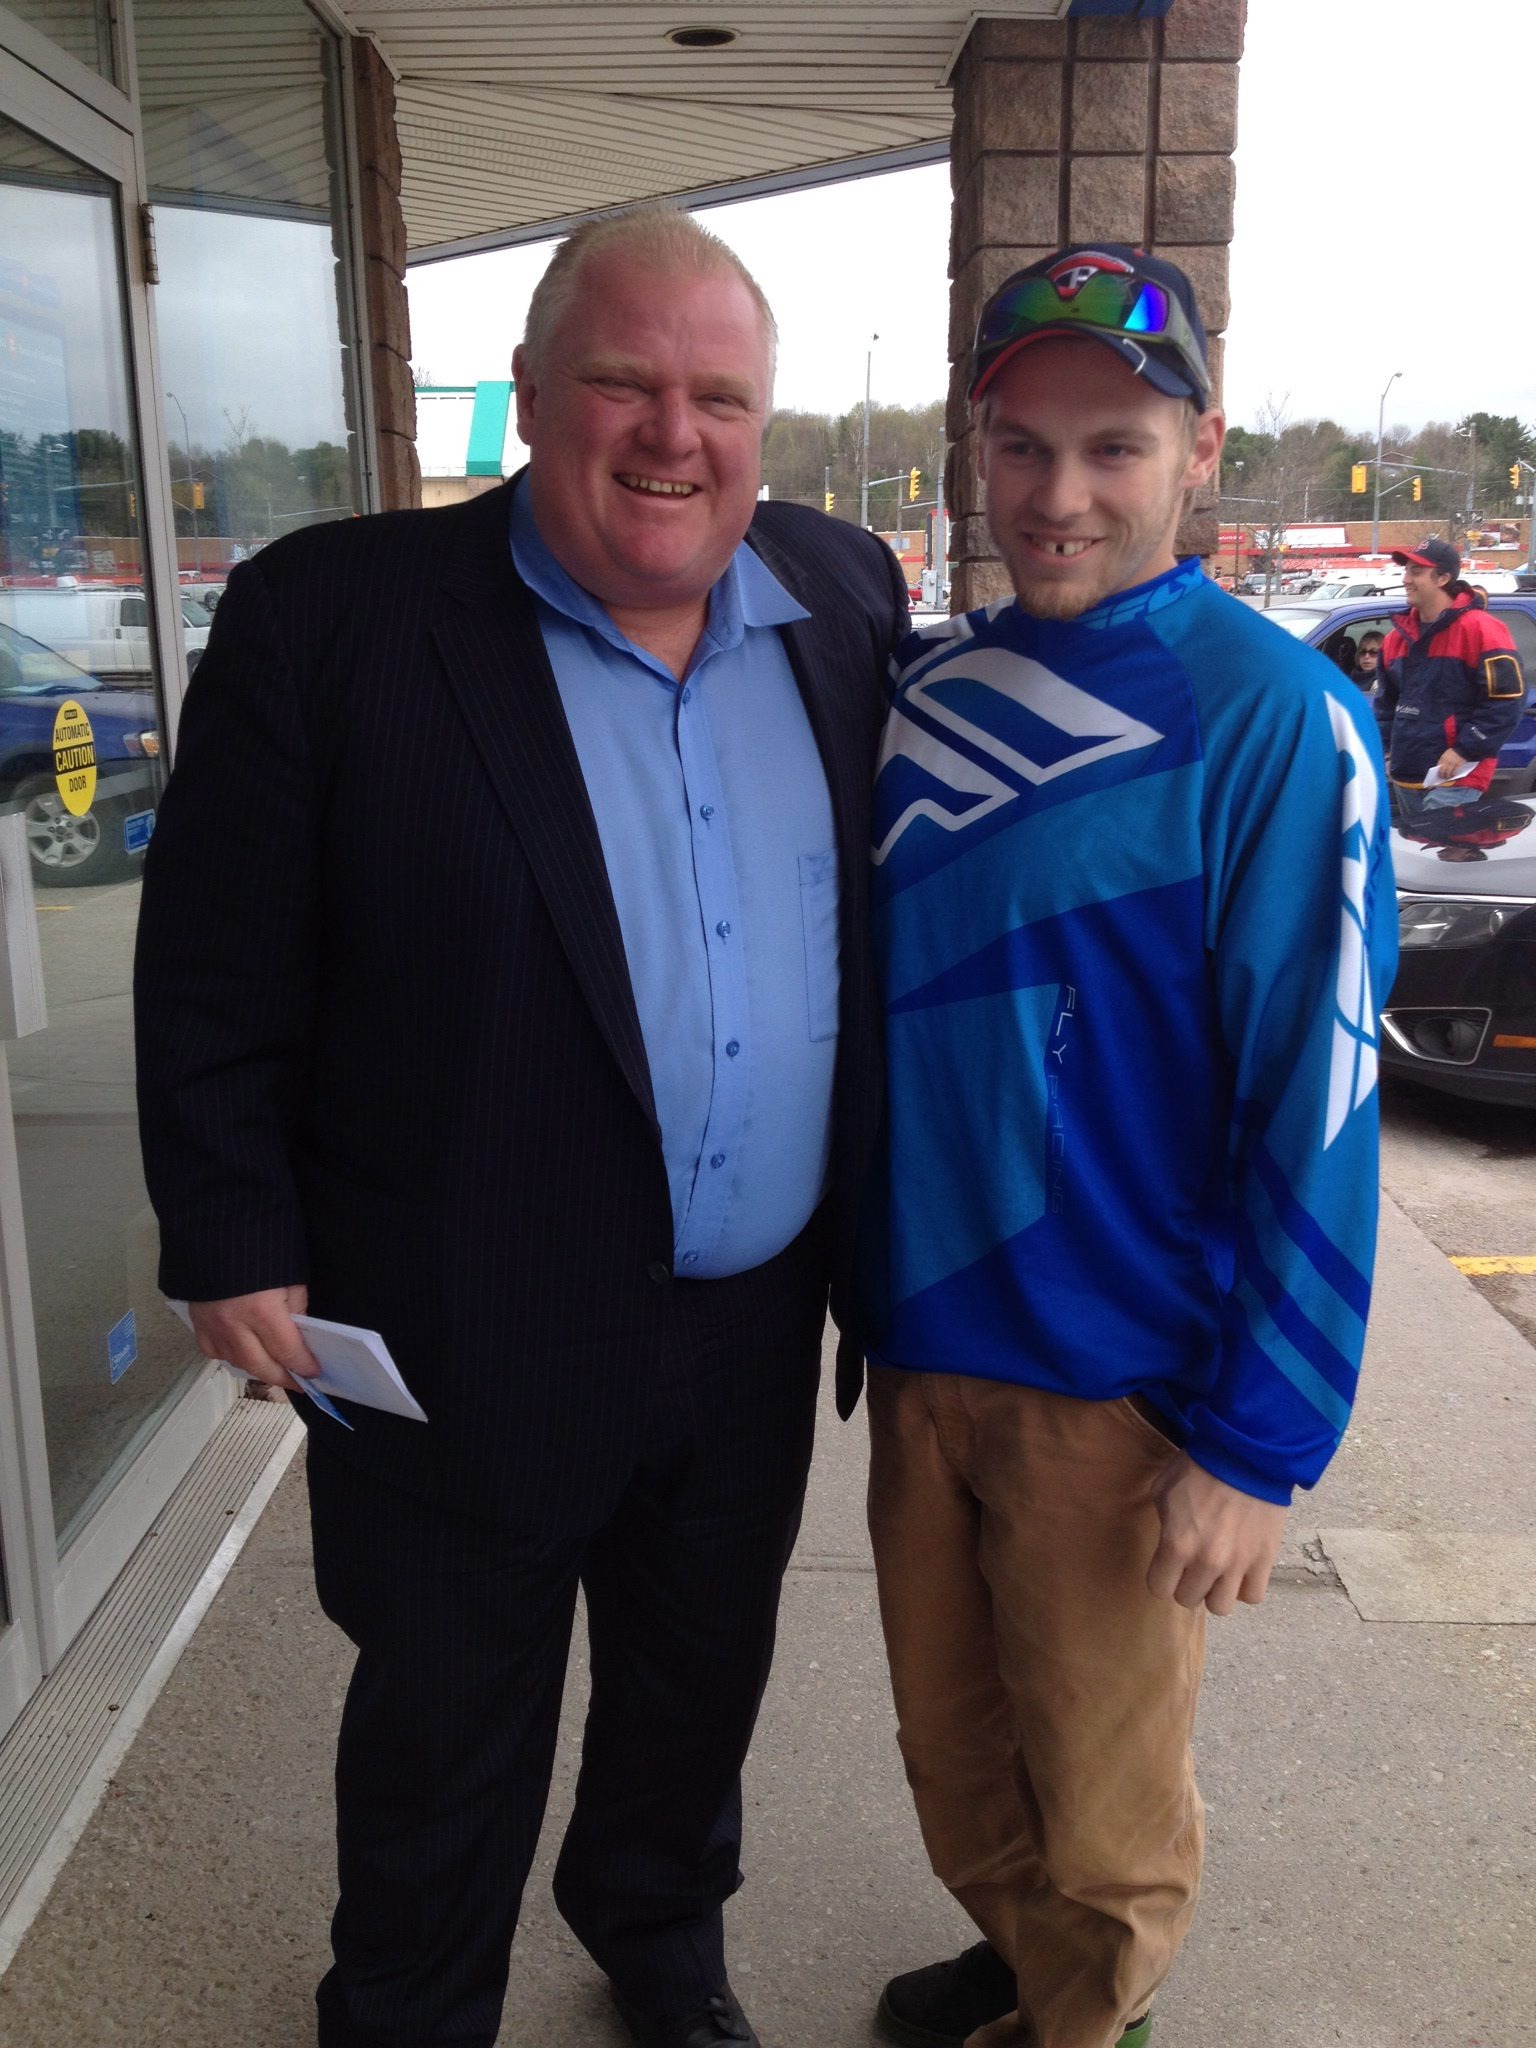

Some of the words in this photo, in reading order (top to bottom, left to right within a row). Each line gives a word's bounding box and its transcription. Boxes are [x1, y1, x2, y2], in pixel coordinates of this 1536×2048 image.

[55, 723, 90, 742] AUTOMATIC
[55, 745, 95, 772] CAUTION
[69, 775, 87, 792] DOOR
[1052, 985, 1076, 1064] FLY
[1047, 1074, 1065, 1216] RACING
